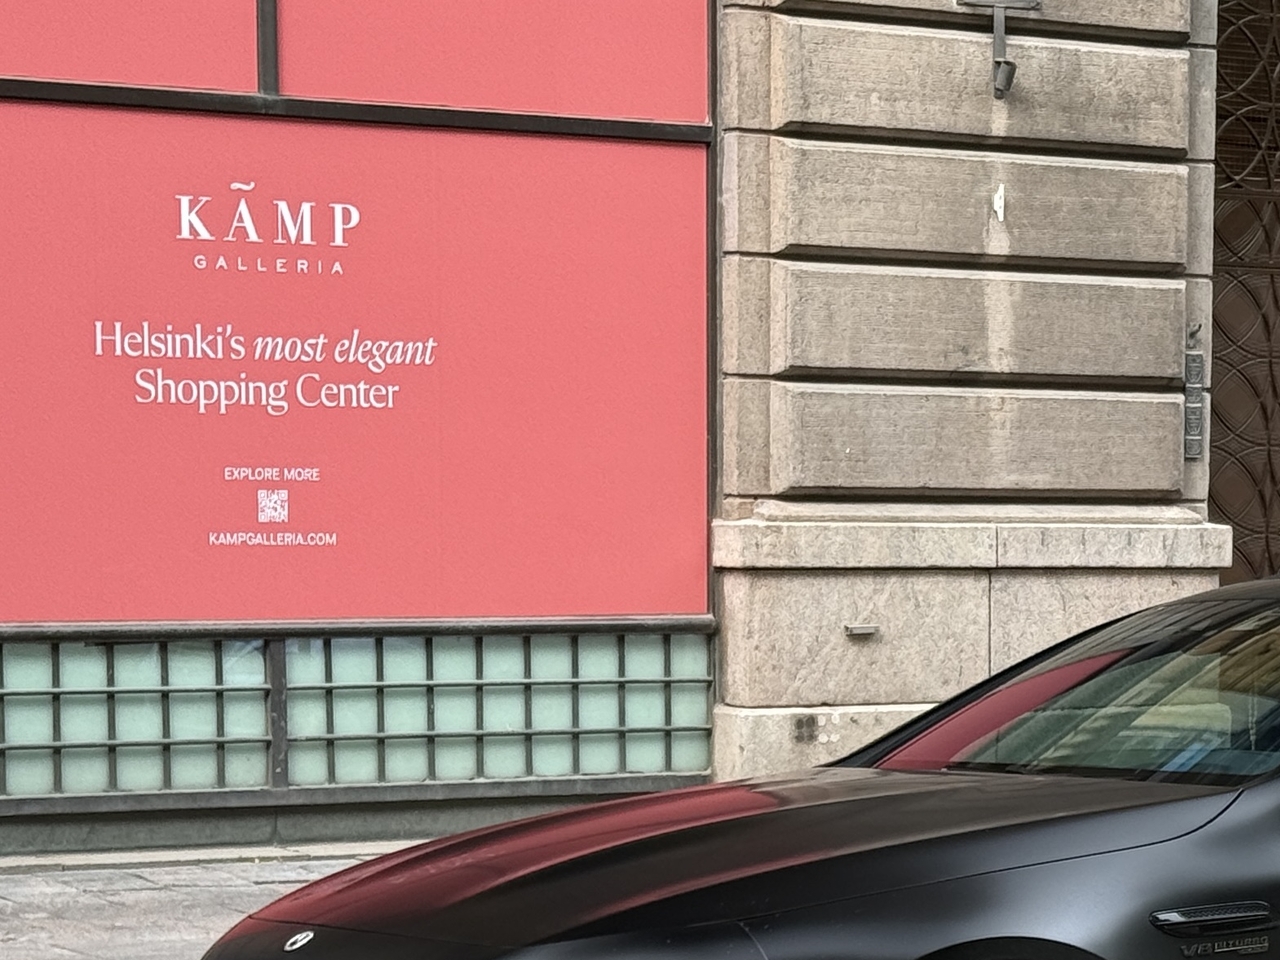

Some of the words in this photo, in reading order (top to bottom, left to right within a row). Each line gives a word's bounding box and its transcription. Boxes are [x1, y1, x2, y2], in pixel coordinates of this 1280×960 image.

[193, 255, 344, 275] GALLERIA
[252, 333, 328, 362] most
[333, 328, 438, 373] elegant
[135, 367, 289, 416] Shopping
[295, 373, 400, 409] Center
[224, 466, 280, 481] EXPLORE
[283, 467, 321, 481] MORE
[209, 531, 337, 546] KAMPGALLERIA.COM
